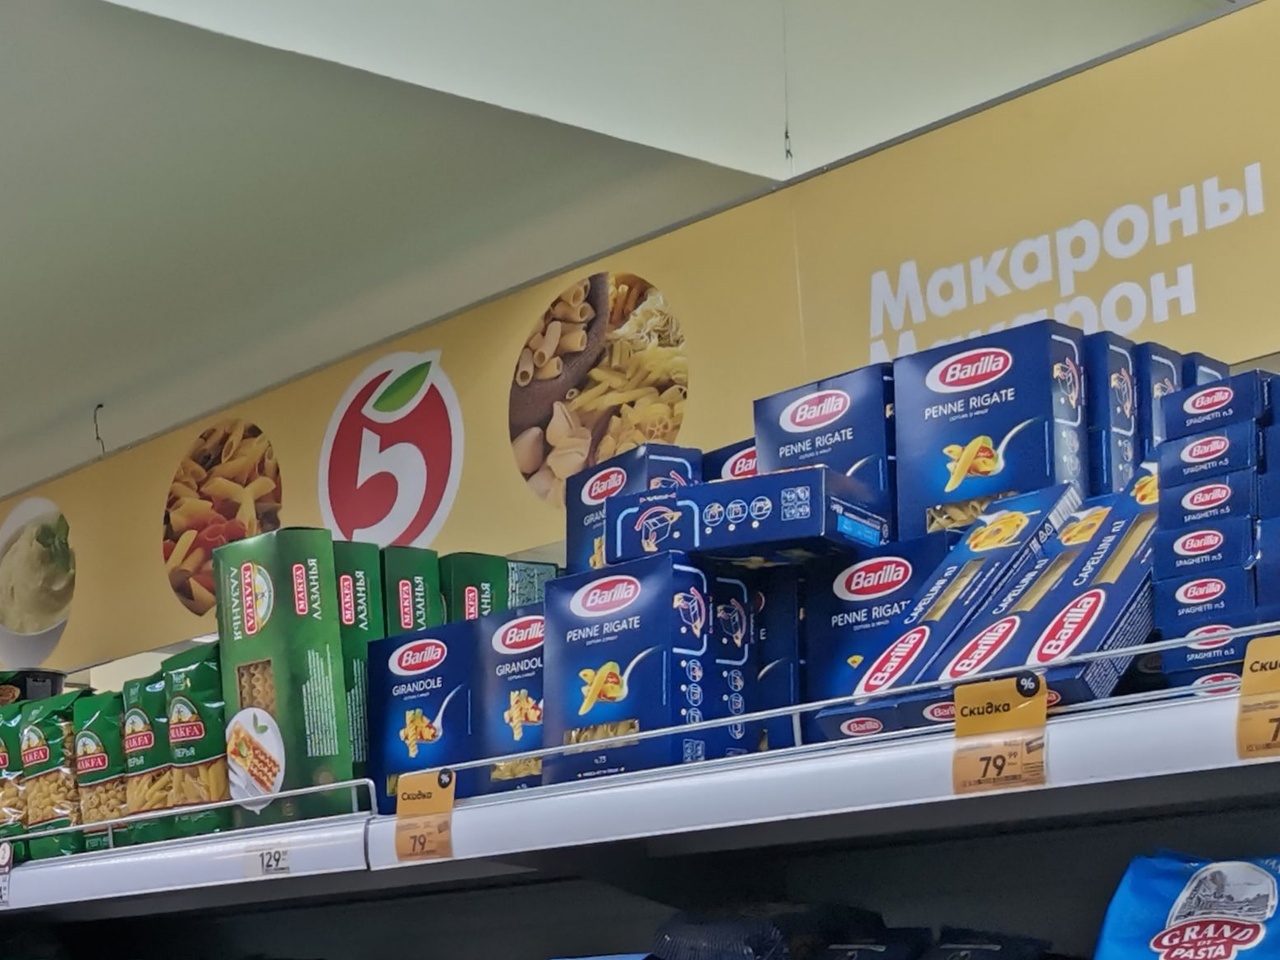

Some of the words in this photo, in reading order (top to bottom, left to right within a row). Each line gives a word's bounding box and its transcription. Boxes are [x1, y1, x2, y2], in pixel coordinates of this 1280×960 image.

[871, 162, 1264, 336] Макароны
[945, 353, 1004, 383] Barilla
[795, 395, 844, 423] Barilla
[925, 399, 964, 420] PENNE
[969, 388, 1016, 408] RIGATE
[1194, 390, 1230, 409] Barilla
[1186, 412, 1221, 426] SPAGHETTI
[779, 440, 813, 458] PENNE
[815, 427, 854, 447] RIGATE
[1192, 441, 1226, 457] Barilla
[1183, 460, 1218, 475] SPAGHETTI
[591, 472, 623, 496] Barilla
[1193, 488, 1227, 505] Barilla
[1184, 509, 1219, 522] SPAGHETTI
[1185, 535, 1219, 550] Barilla
[1073, 532, 1116, 587] CAPELLINI
[1175, 555, 1210, 567] SPAGHETTI
[850, 564, 905, 590] Barilla
[308, 558, 322, 620] ЛАЗАНЬЯ
[355, 570, 368, 630] ЛАЗАНЬЯ
[585, 585, 635, 608] Barilla
[993, 571, 1033, 615] CAPELLINI
[1187, 583, 1222, 598] Barilla
[904, 577, 944, 625] CAPELLINI
[1178, 603, 1213, 616] SPAGHETTI
[831, 609, 869, 628] PENNE
[872, 599, 910, 619] RIGAT
[567, 623, 600, 643] PENNE
[603, 615, 641, 634] RIGATE
[1044, 596, 1096, 656] Barilla
[401, 647, 442, 668] Barilla
[958, 620, 1011, 673] Barilla
[1187, 650, 1222, 661] SPAGHETTI
[496, 656, 543, 676] GIRANDOL
[870, 632, 922, 687] Barilla
[392, 676, 442, 697] GIRANDOLE
[960, 701, 1011, 718] Скидка
[849, 720, 879, 733] Barilla
[980, 754, 1007, 778] 79
[401, 790, 433, 801] Скидка
[410, 833, 427, 854] 79
[259, 851, 282, 872] 129
[1160, 920, 1256, 949] GRAND
